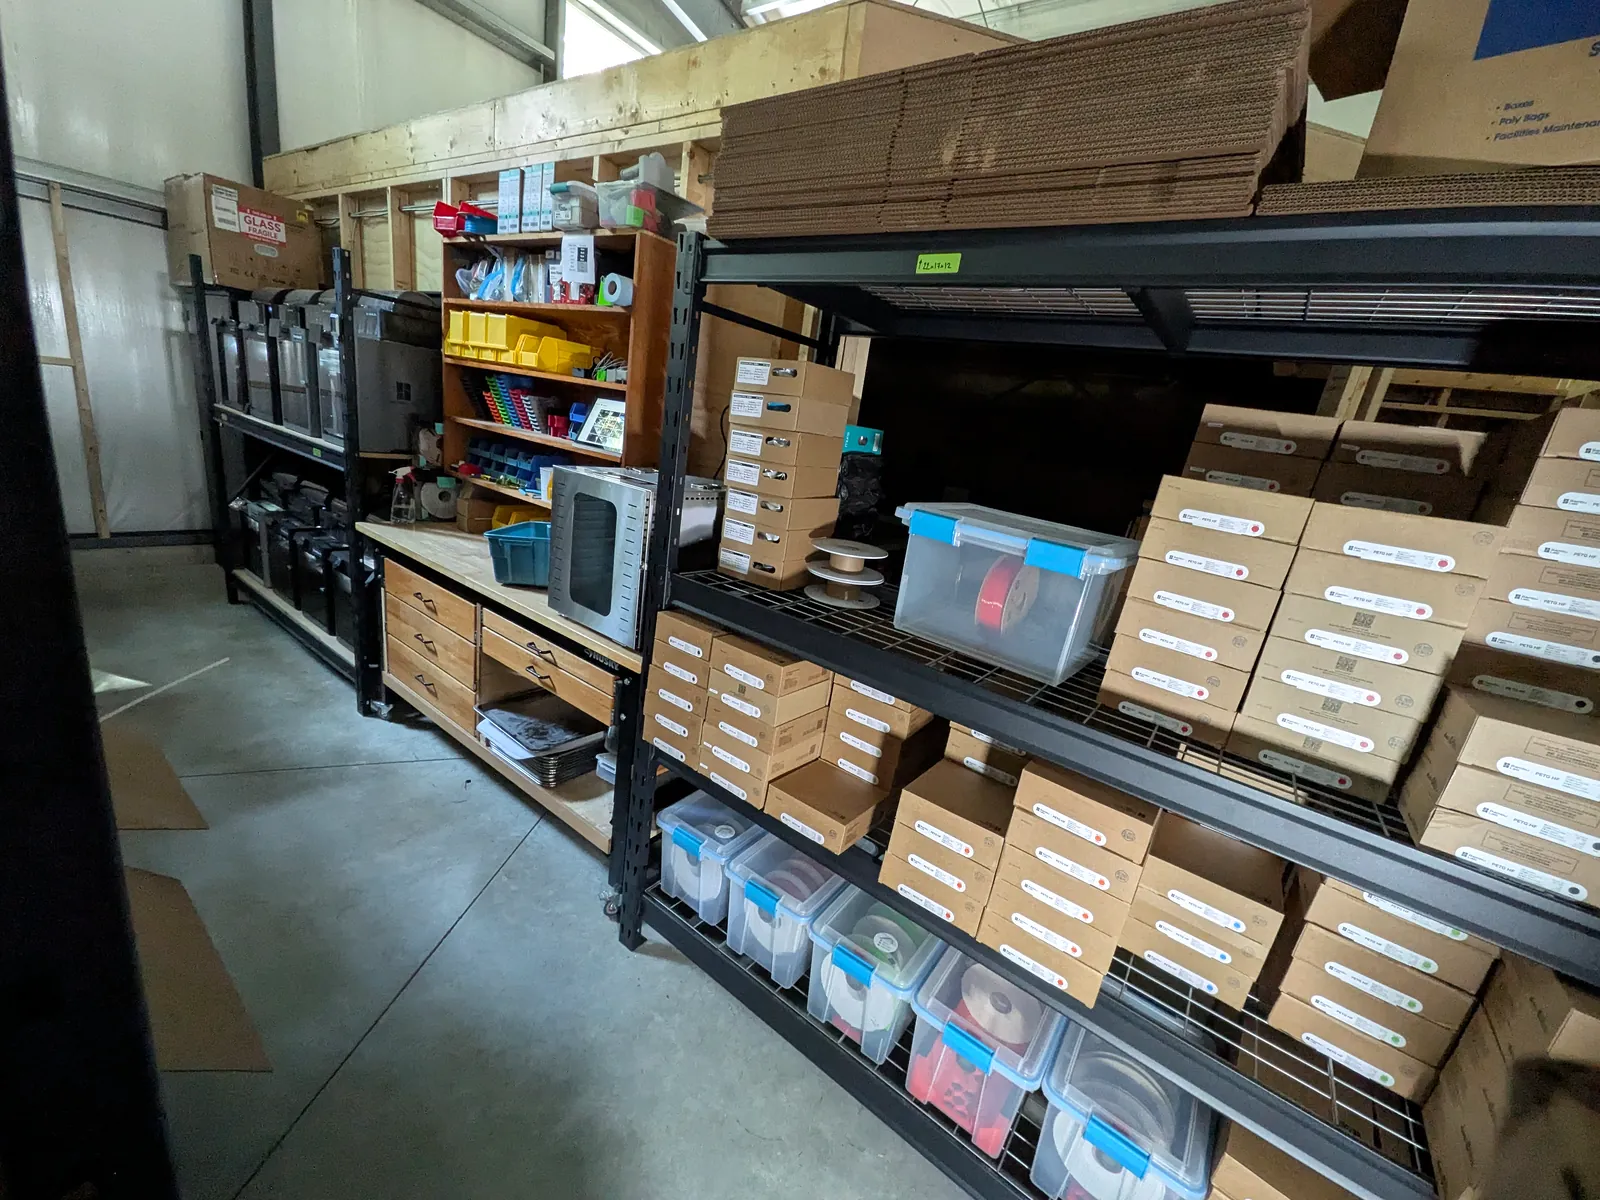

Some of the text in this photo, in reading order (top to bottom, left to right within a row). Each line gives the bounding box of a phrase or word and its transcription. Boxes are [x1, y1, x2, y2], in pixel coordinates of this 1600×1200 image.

[1504, 100, 1534, 110] Boxes
[1499, 112, 1551, 126] Poly Bags
[1494, 128, 1540, 141] Facilities
[244, 215, 281, 232] GLASS
[248, 226, 277, 239] FRAGILE
[592, 650, 620, 671] HUSKY
[1513, 818, 1528, 826] PETG
[1491, 862, 1506, 870] PETG
